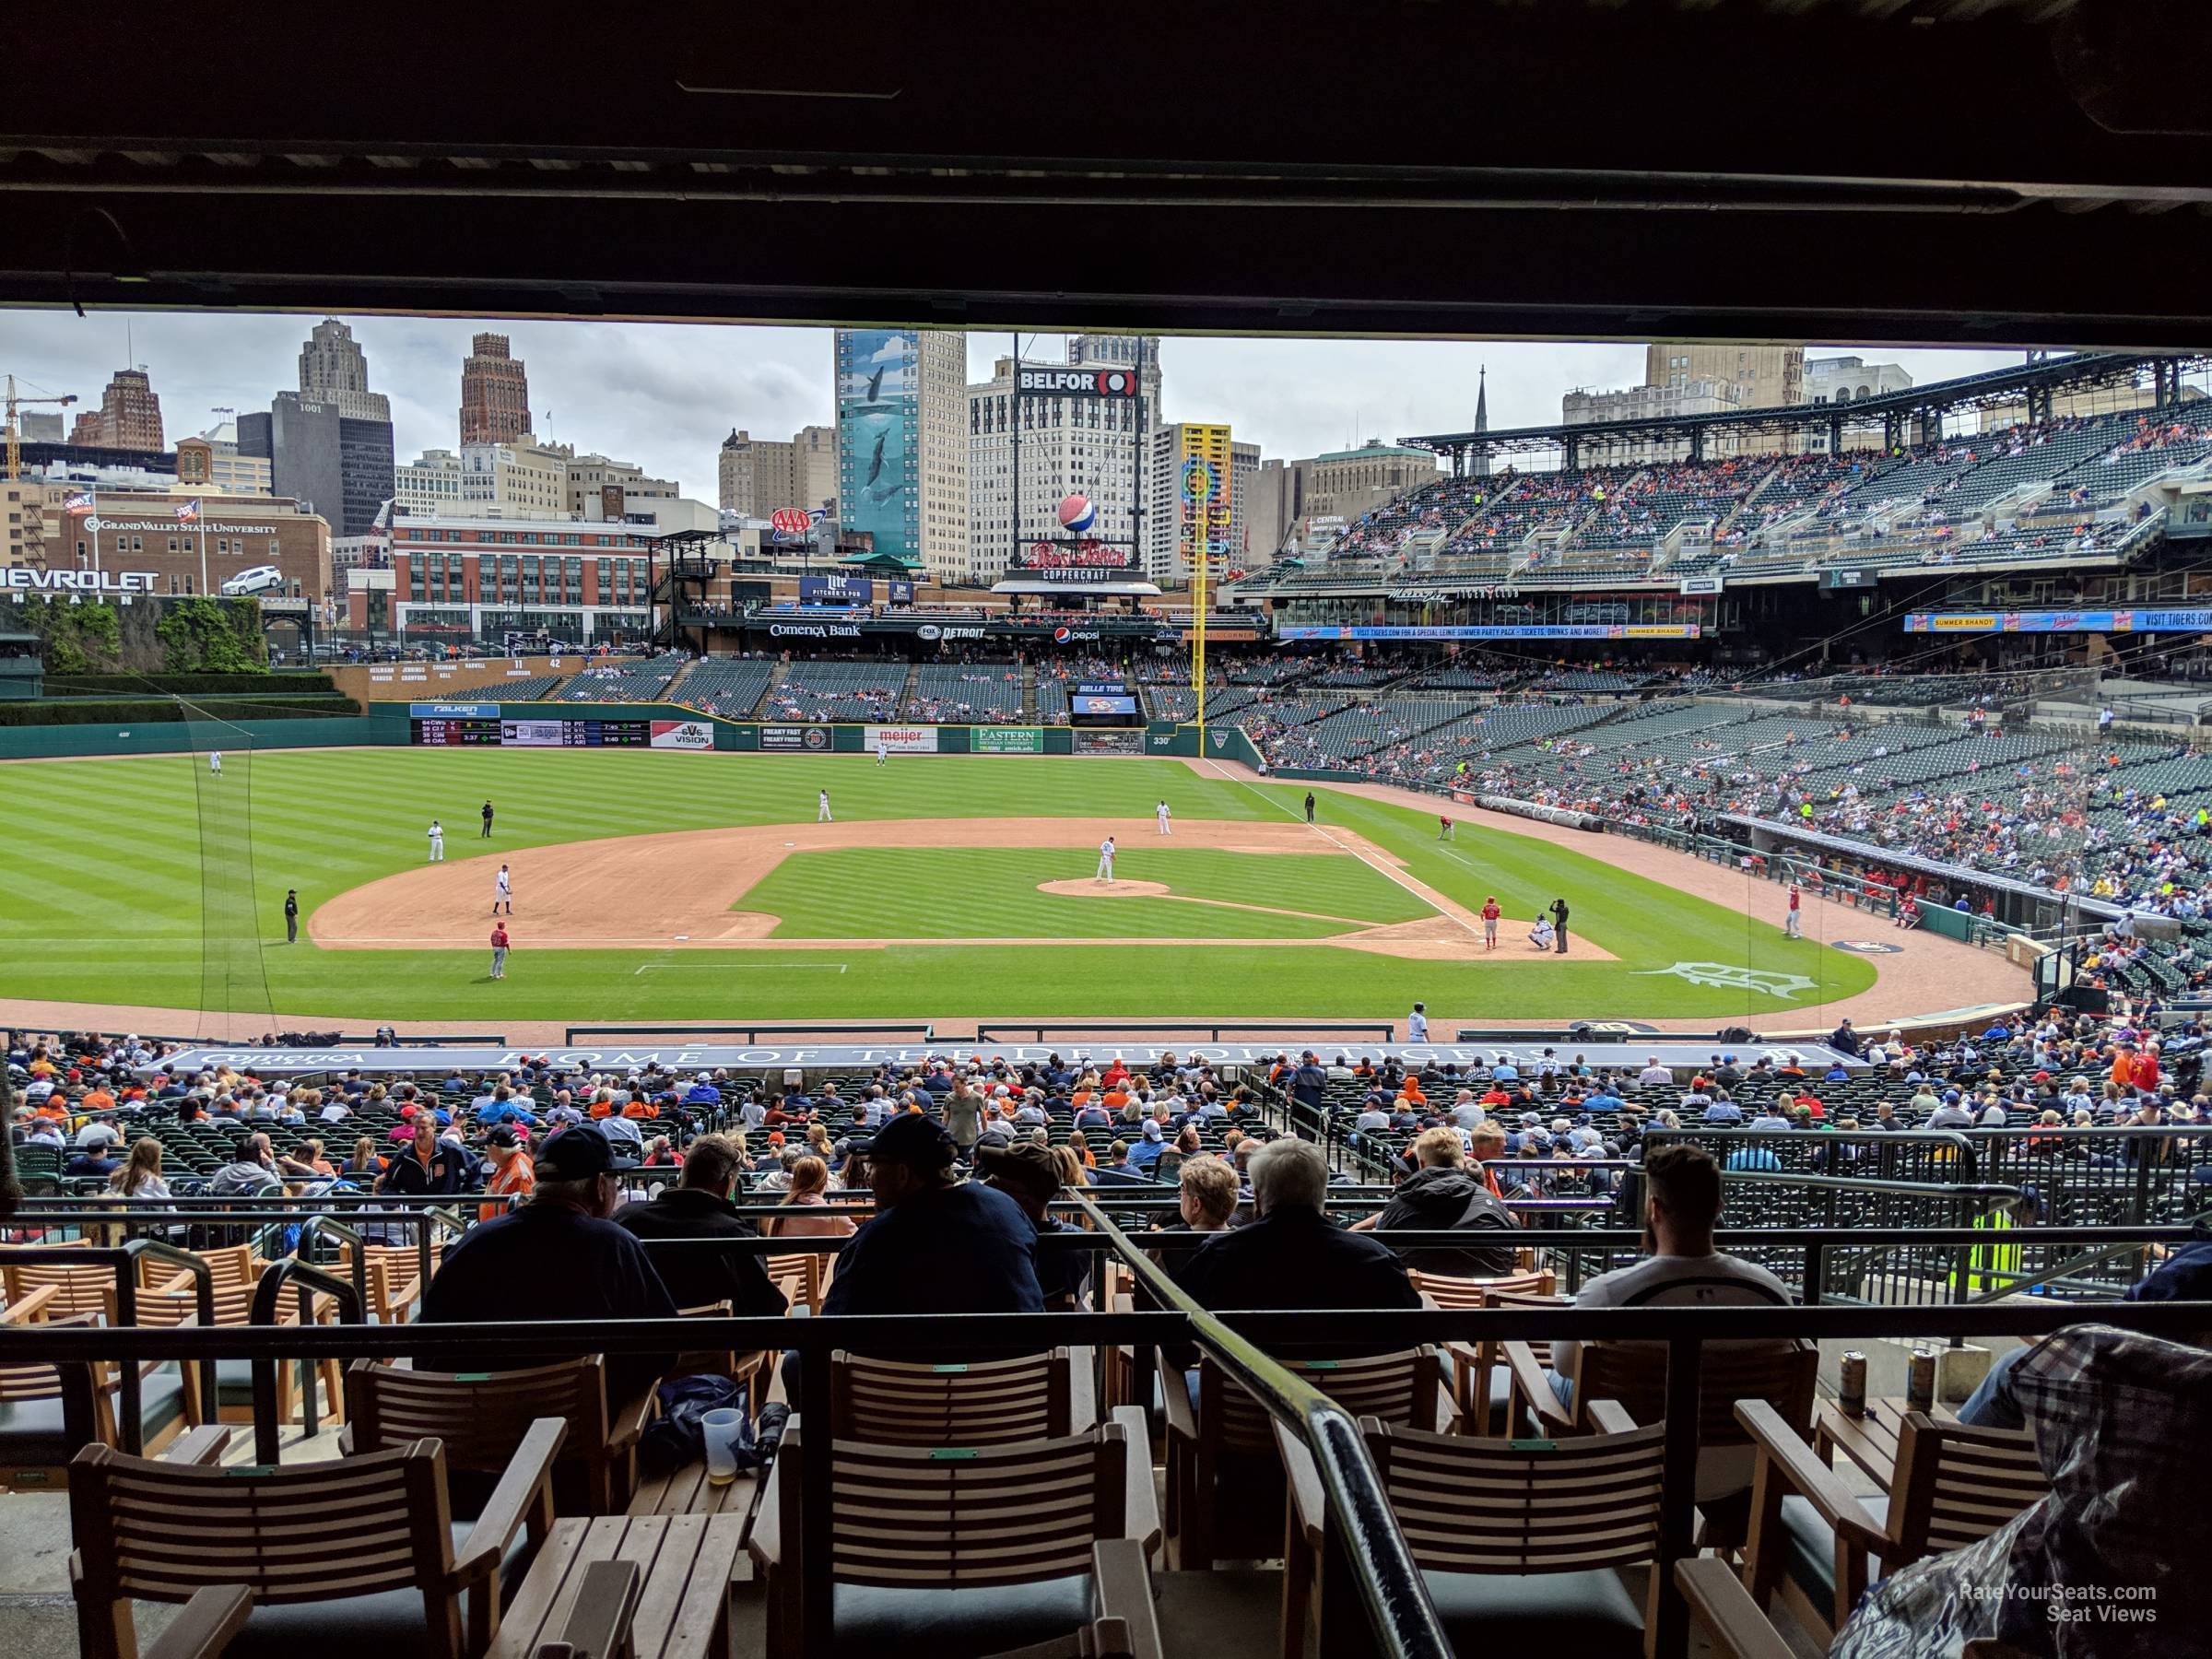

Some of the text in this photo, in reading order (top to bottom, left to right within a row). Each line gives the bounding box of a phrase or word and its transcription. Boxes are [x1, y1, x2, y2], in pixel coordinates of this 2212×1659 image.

[1020, 372, 1094, 390] BELFOR
[300, 403, 321, 413] 1001
[775, 510, 809, 532] AAA
[212, 523, 277, 534] UNIVERSITY
[1043, 571, 1111, 580] COPPERCRAFT
[1456, 588, 1519, 599] TIGER CLUB
[2146, 614, 2166, 626] VISIT
[830, 625, 861, 637] Bank
[923, 628, 985, 639] FOX DETROIT
[1072, 630, 1100, 642] pepsi
[1501, 628, 1515, 636] PACK
[1570, 628, 1583, 636] AND
[515, 660, 523, 669] 11
[549, 659, 560, 668] 42
[675, 735, 710, 744] VISION
[880, 728, 922, 744] meijer
[980, 729, 1034, 740] EASTERN
[498, 1052, 702, 1064] HOME
[737, 1051, 819, 1062] OF
[852, 1049, 973, 1062] THE
[1325, 1046, 1555, 1060] TIGERS
